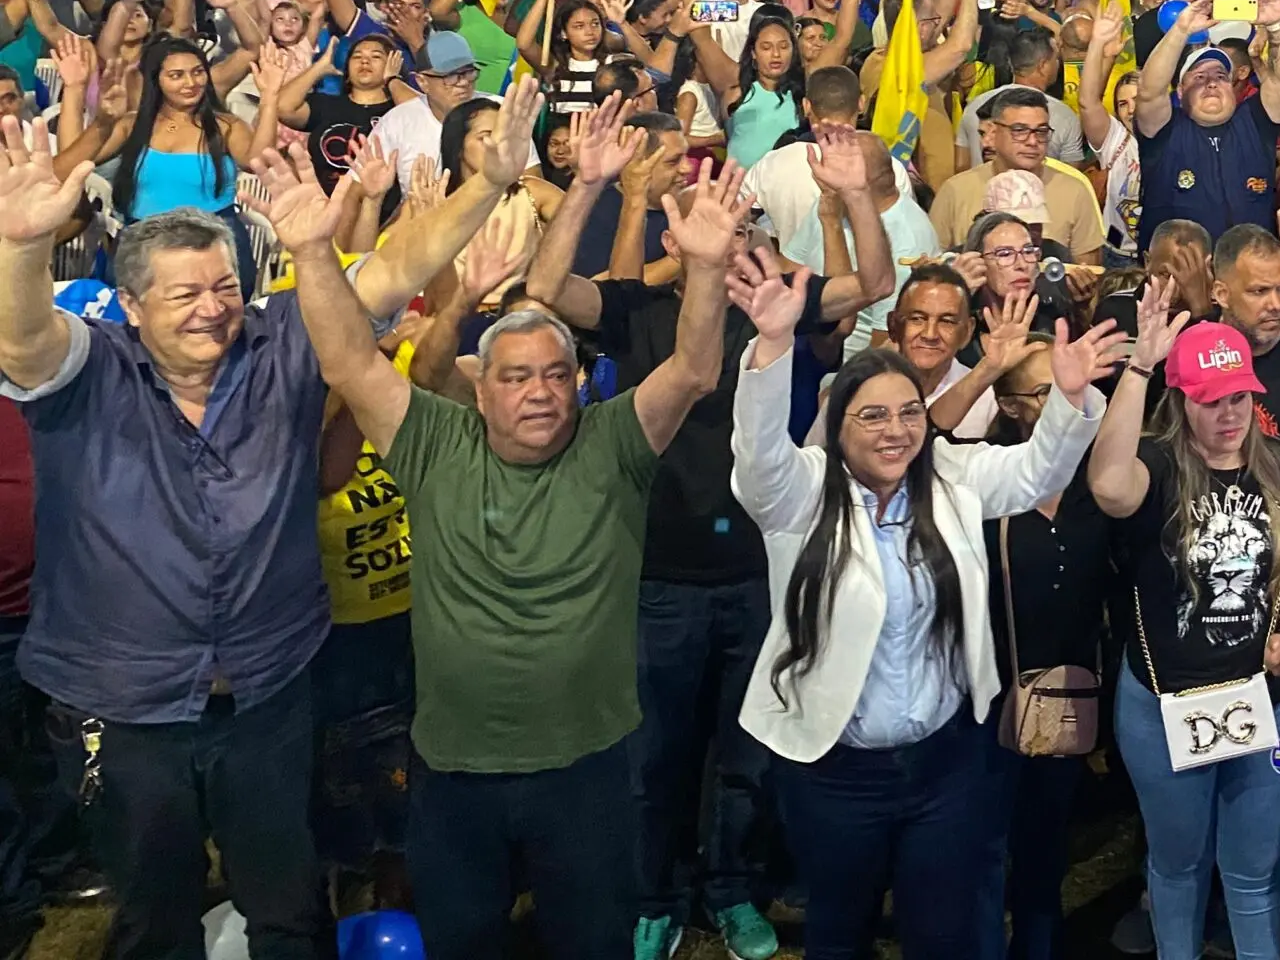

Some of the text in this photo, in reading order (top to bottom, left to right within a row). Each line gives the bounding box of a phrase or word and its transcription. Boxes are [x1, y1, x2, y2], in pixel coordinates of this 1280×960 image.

[1198, 347, 1242, 369] Lipin
[1191, 492, 1263, 522] CORAGEM
[1184, 700, 1257, 755] DG
